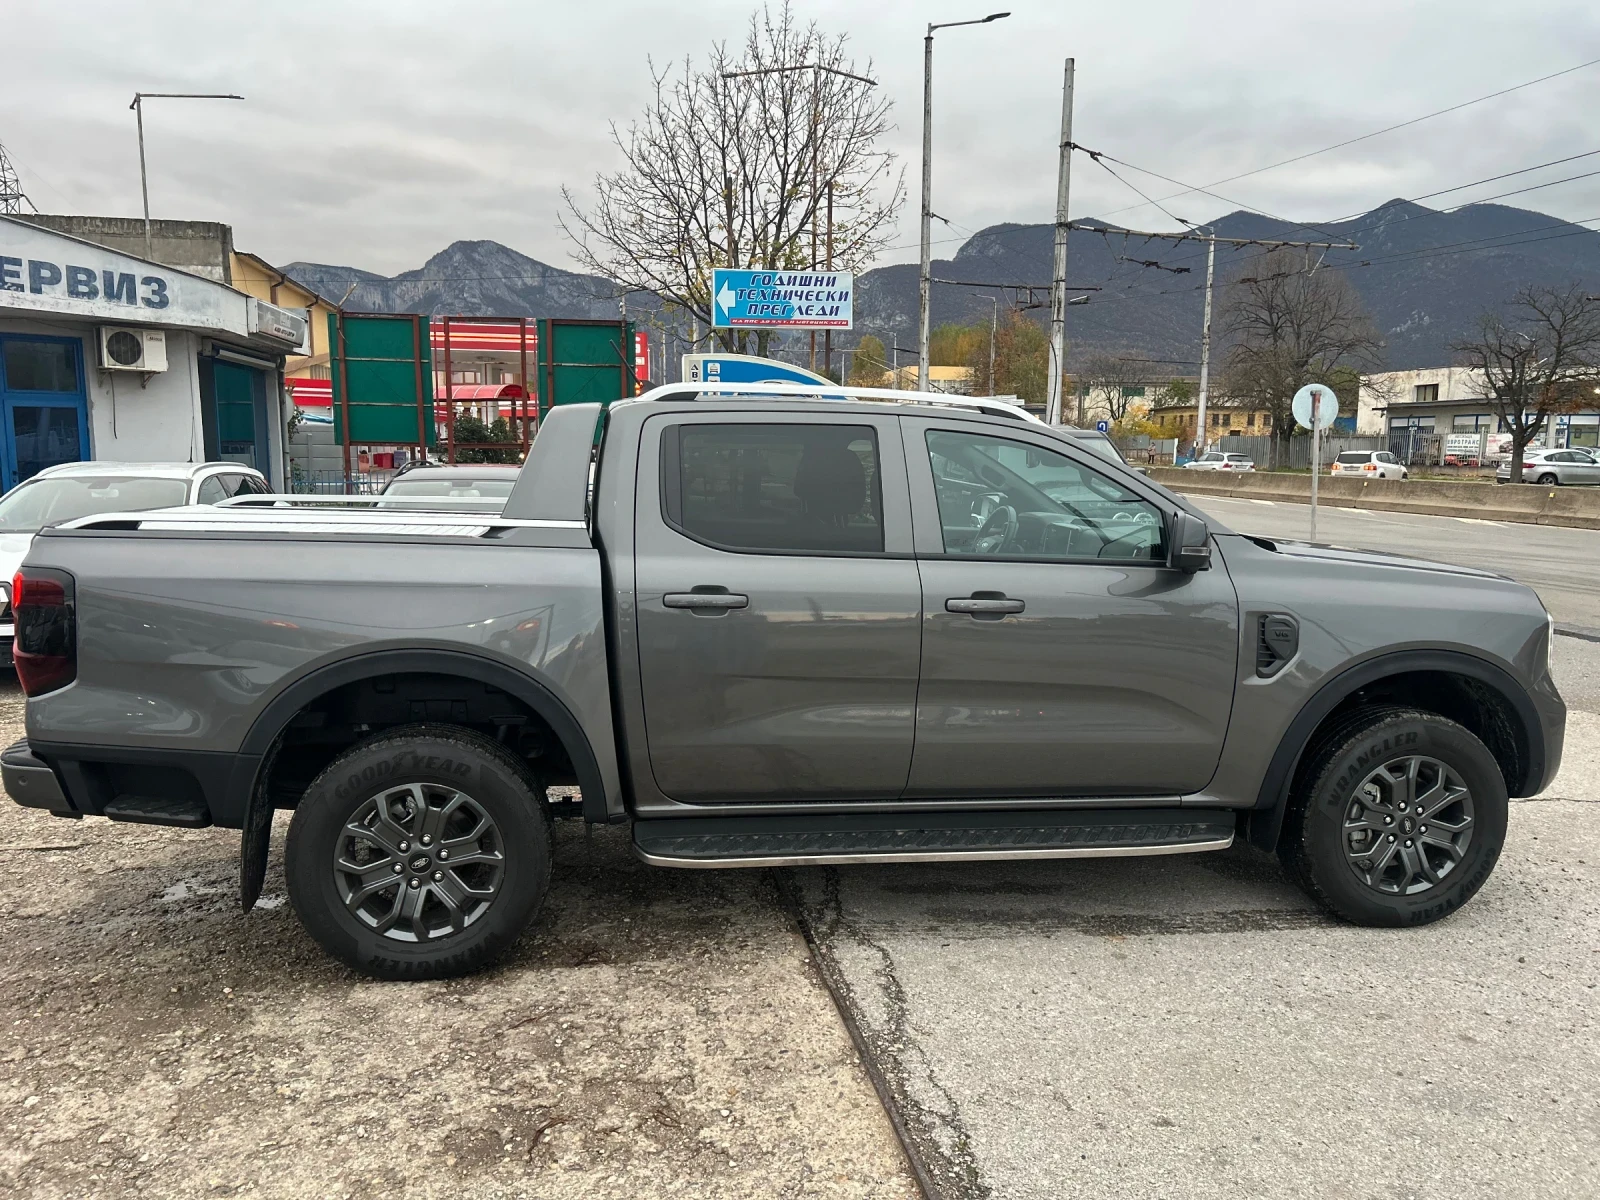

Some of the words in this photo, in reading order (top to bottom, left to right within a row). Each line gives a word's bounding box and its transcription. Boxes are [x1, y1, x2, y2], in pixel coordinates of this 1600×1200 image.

[750, 274, 837, 287] ГОДИШНИ
[737, 288, 849, 302] ТЕХНИЧЕСКИ
[746, 303, 840, 316] ПРЕГЛЕДИ
[1328, 731, 1418, 808] WRANGLER
